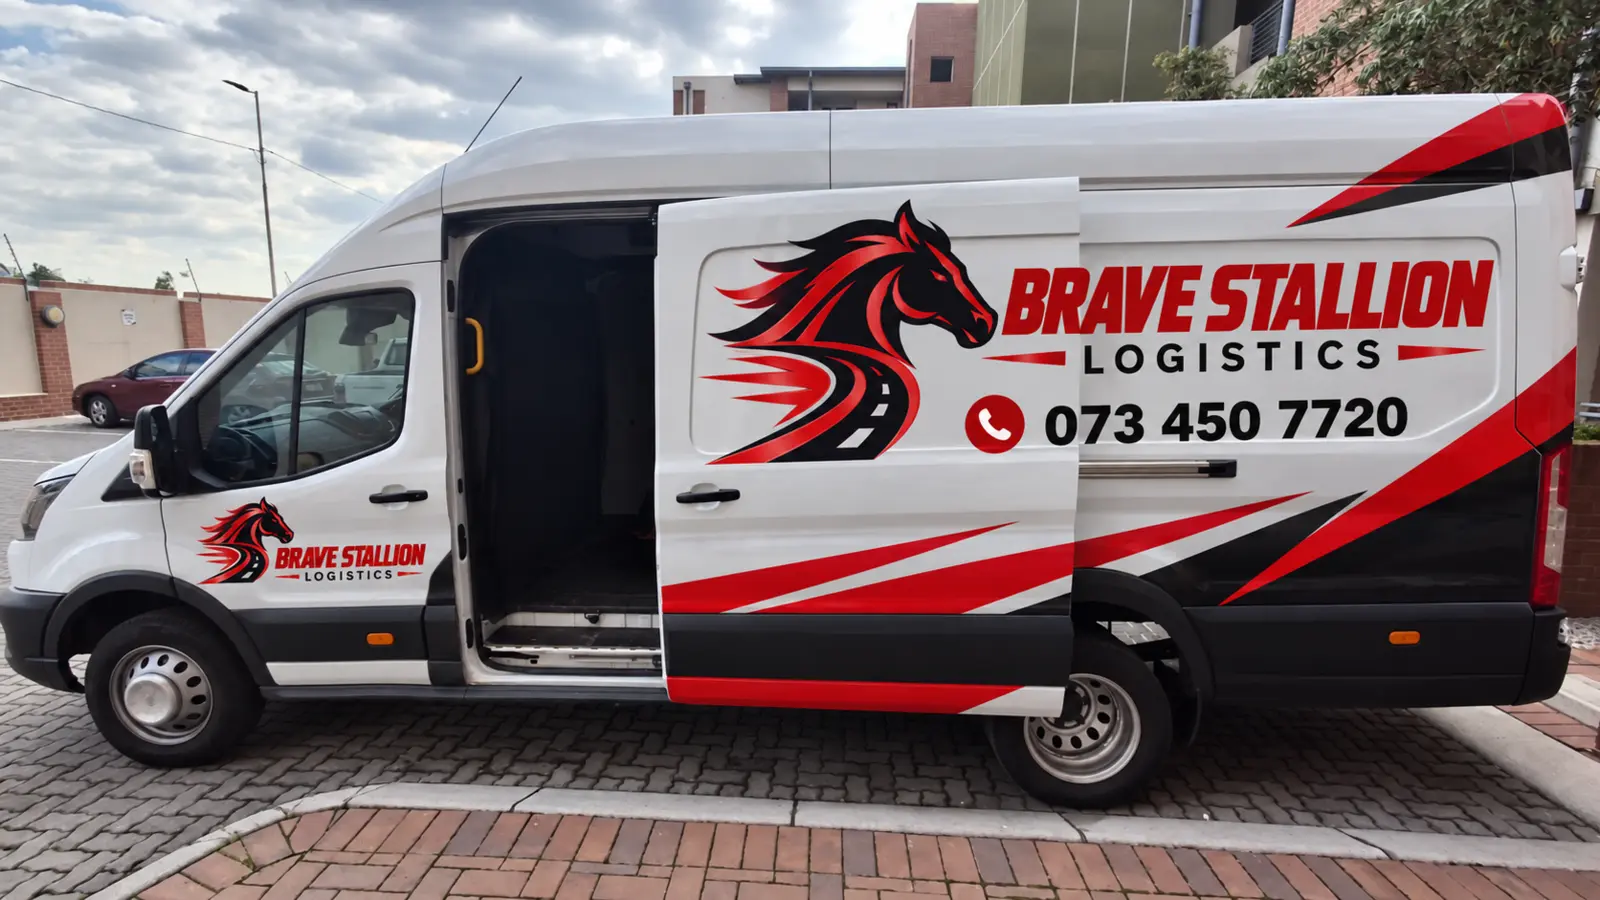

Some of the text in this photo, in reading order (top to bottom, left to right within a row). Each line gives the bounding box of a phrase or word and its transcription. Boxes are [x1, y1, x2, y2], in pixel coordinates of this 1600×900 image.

[1001, 260, 1494, 335] BRAVE STALLION
[1084, 339, 1381, 375] LOGISTICS
[1045, 396, 1408, 446] 073 450 7720
[275, 543, 427, 569] BRAVE STALLION
[305, 569, 393, 582] LOGISTICS
